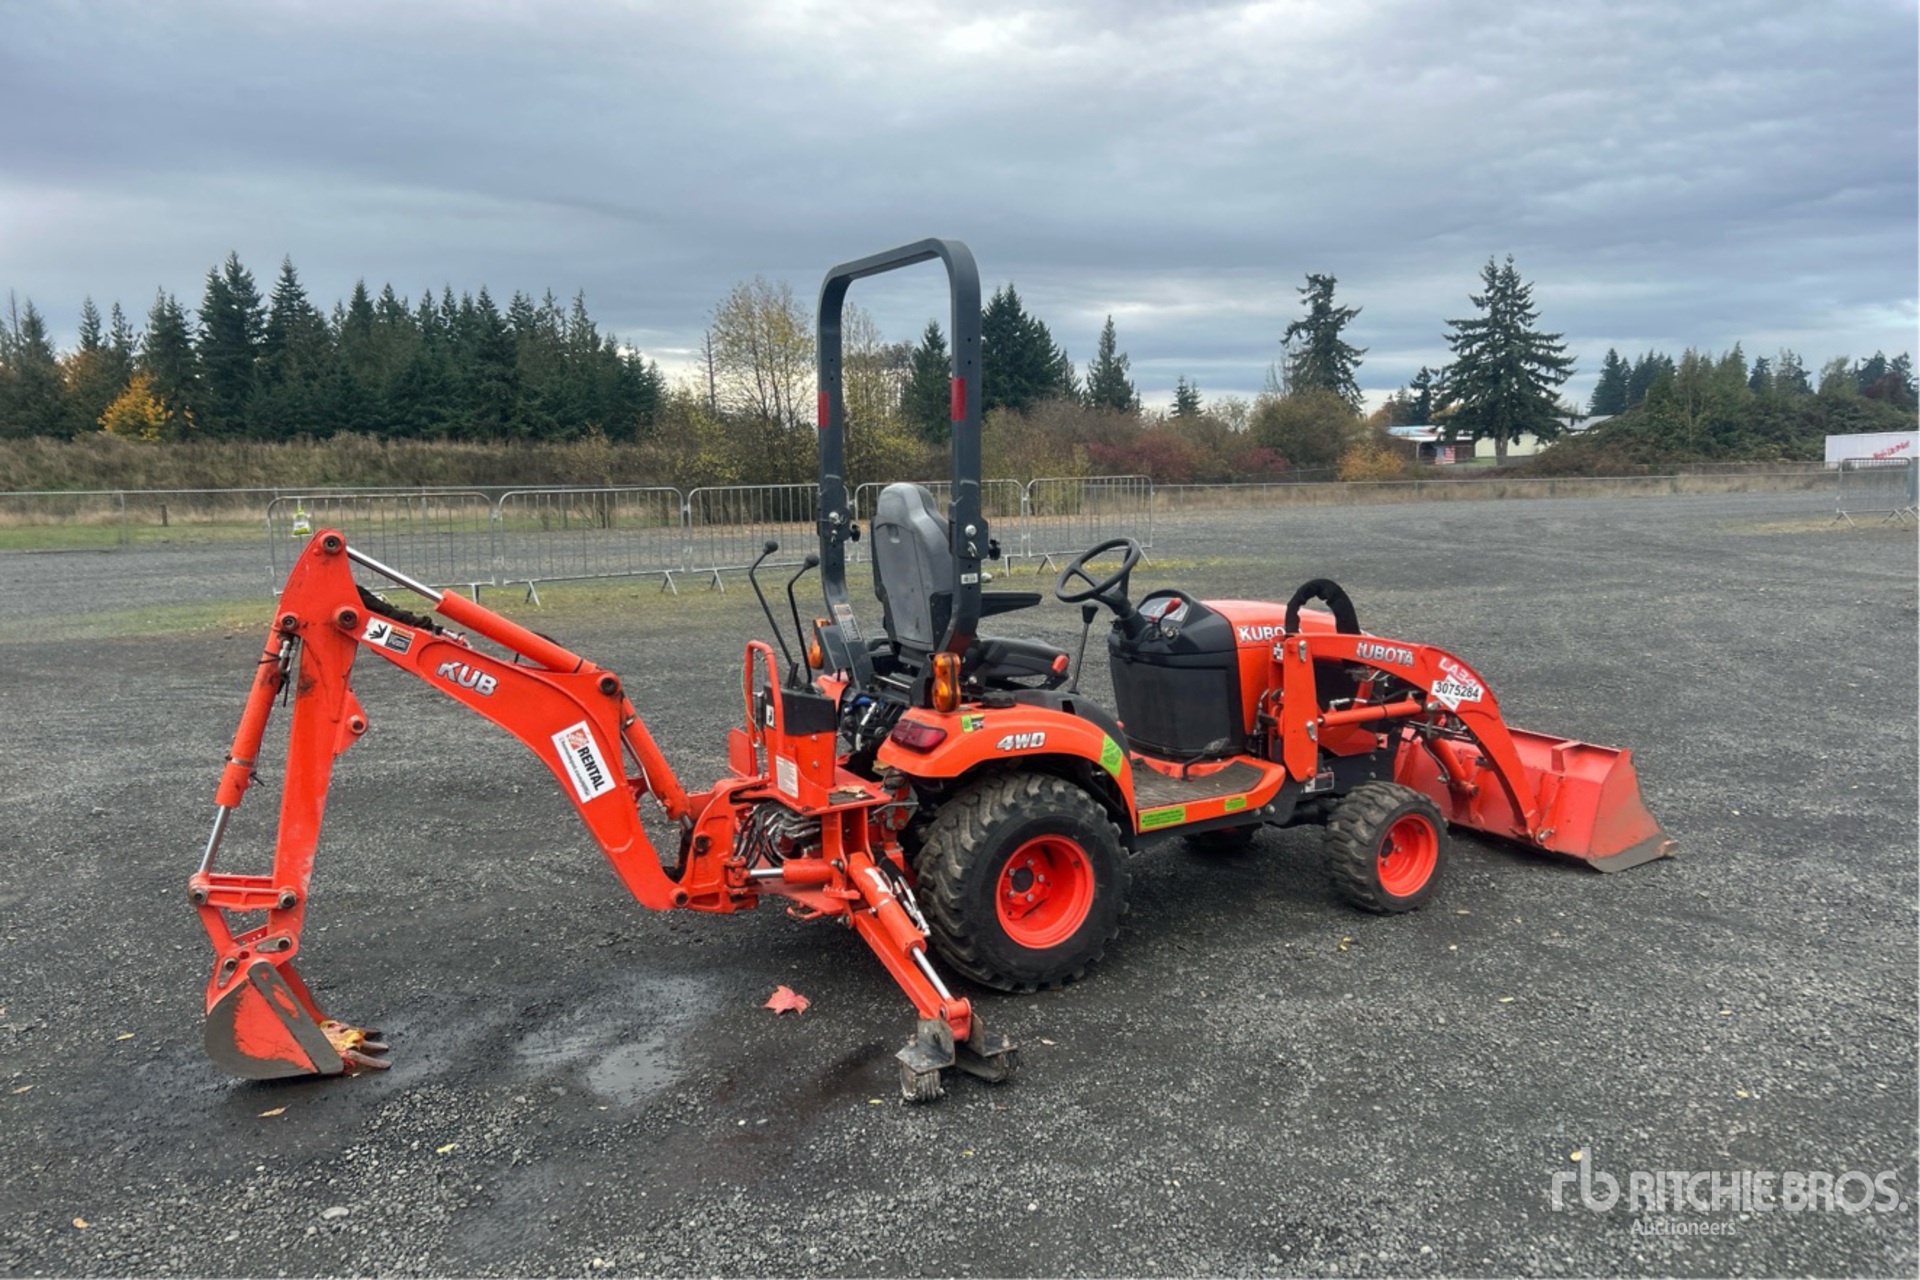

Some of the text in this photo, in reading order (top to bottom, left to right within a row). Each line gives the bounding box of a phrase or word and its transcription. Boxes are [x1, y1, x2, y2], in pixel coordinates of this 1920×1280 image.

[436, 661, 499, 696] KUB
[1435, 681, 1480, 698] 3075284
[996, 731, 1046, 751] 4WD
[577, 746, 605, 791] RENTAL
